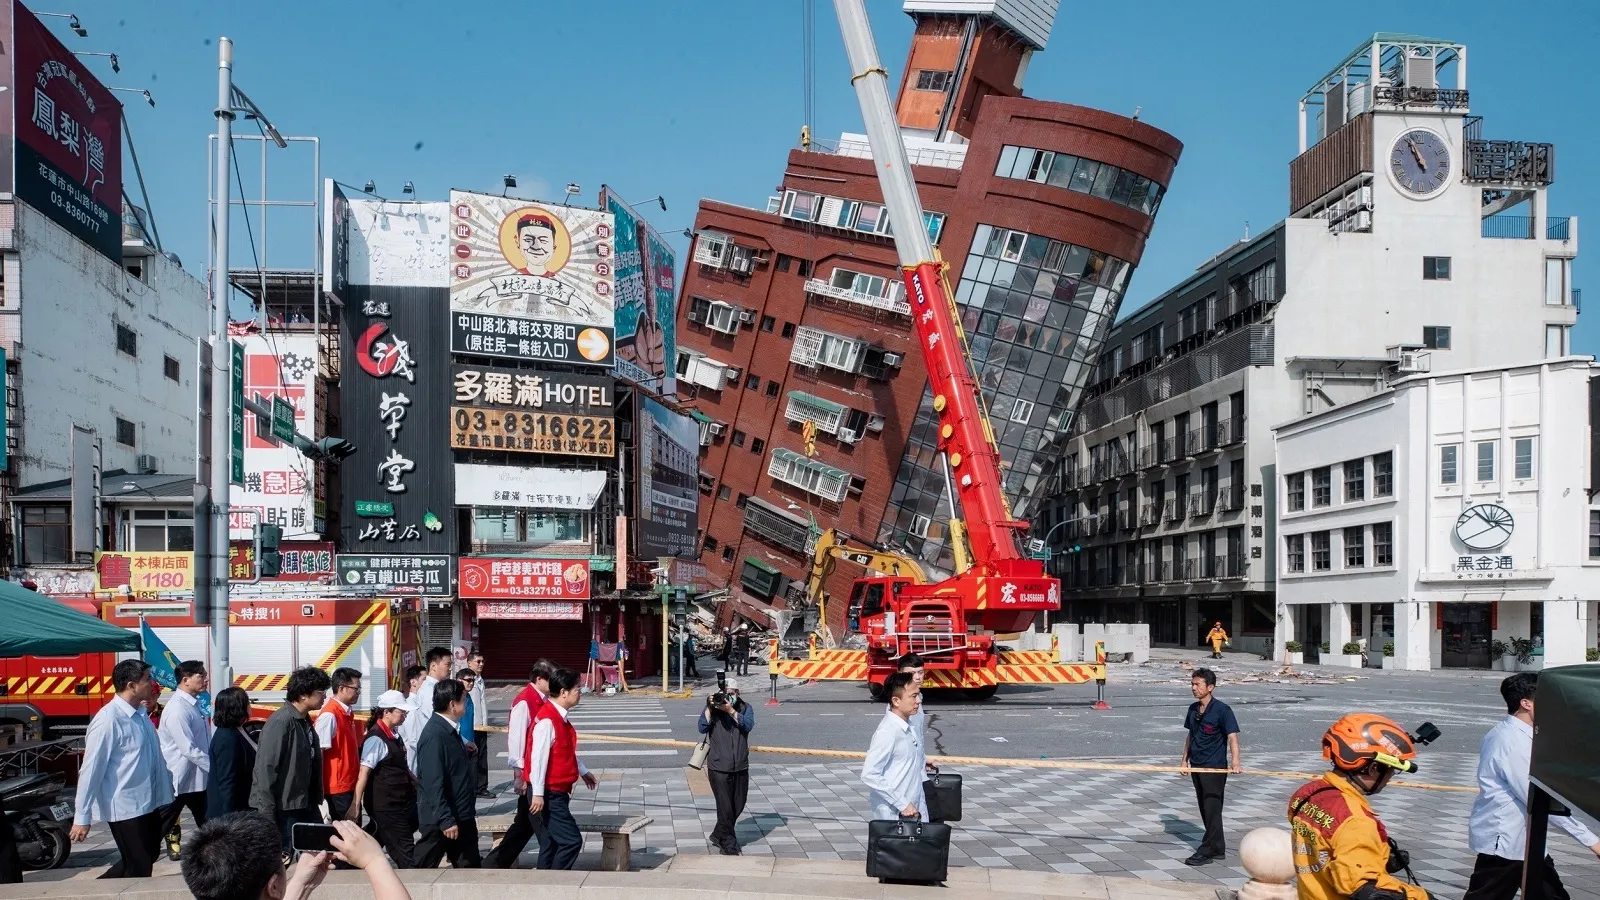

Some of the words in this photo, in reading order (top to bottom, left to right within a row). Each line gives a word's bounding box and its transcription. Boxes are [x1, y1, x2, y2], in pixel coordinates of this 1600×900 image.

[50, 190, 100, 234] 03-8360777
[456, 204, 471, 278] 僅此一家
[596, 226, 609, 296] 別無分號
[912, 273, 925, 304] KATO
[362, 300, 391, 316] 花蓮
[458, 314, 576, 341] 中山路北濱街交叉路口
[465, 334, 569, 359] (原住民一條街入口)
[233, 364, 243, 435] 中山路
[453, 370, 544, 408] 多羅滿
[545, 382, 613, 407] HOTEL
[455, 408, 613, 440] 03-8316622
[358, 518, 420, 541] 山苦瓜
[96, 554, 131, 589] 售
[134, 556, 189, 569] 本棟店面
[370, 558, 422, 568] 健康伴手禮
[857, 554, 868, 565] CAT
[1456, 555, 1514, 571] 黑金通
[143, 572, 184, 587] 1180
[363, 570, 440, 585] 有機山苦瓜
[509, 586, 562, 595] 03-8327130
[240, 607, 281, 620] 特搜11
